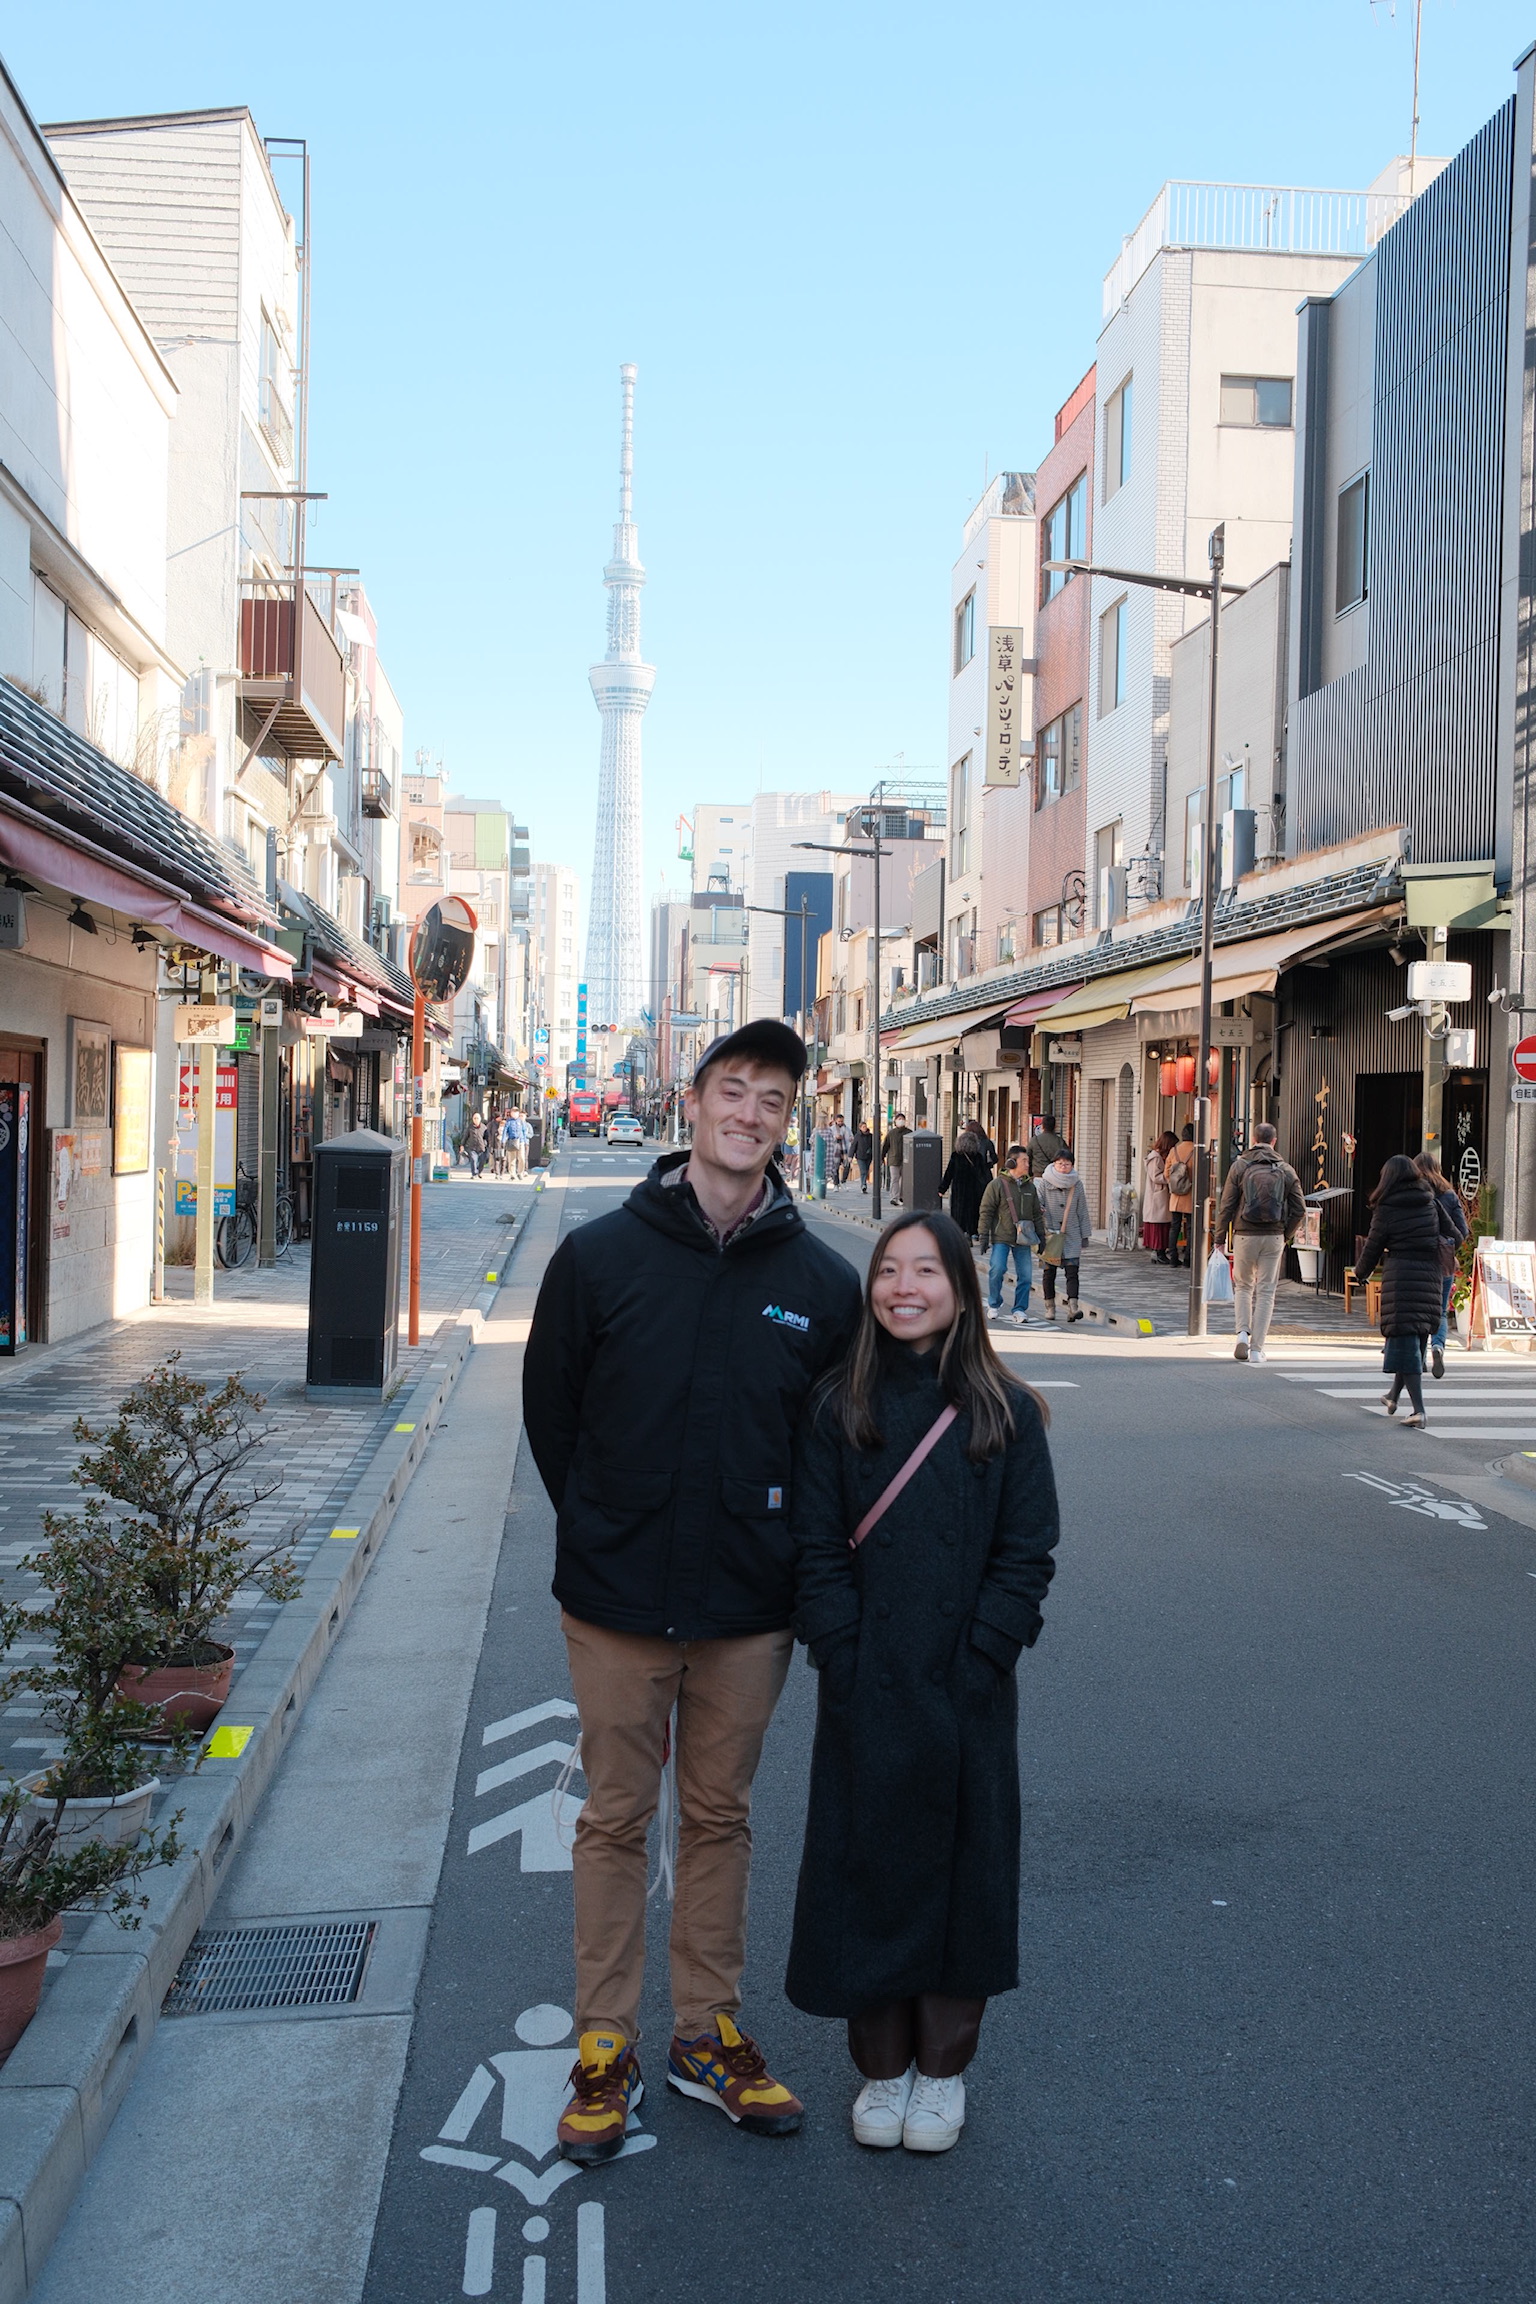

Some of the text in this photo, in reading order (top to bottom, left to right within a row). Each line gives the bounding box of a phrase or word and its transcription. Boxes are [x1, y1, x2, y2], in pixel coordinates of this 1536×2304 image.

[995, 634, 1015, 776] 浅草パンツェロッティ
[1428, 979, 1456, 987] 七五三
[1219, 1028, 1244, 1037] 七五三
